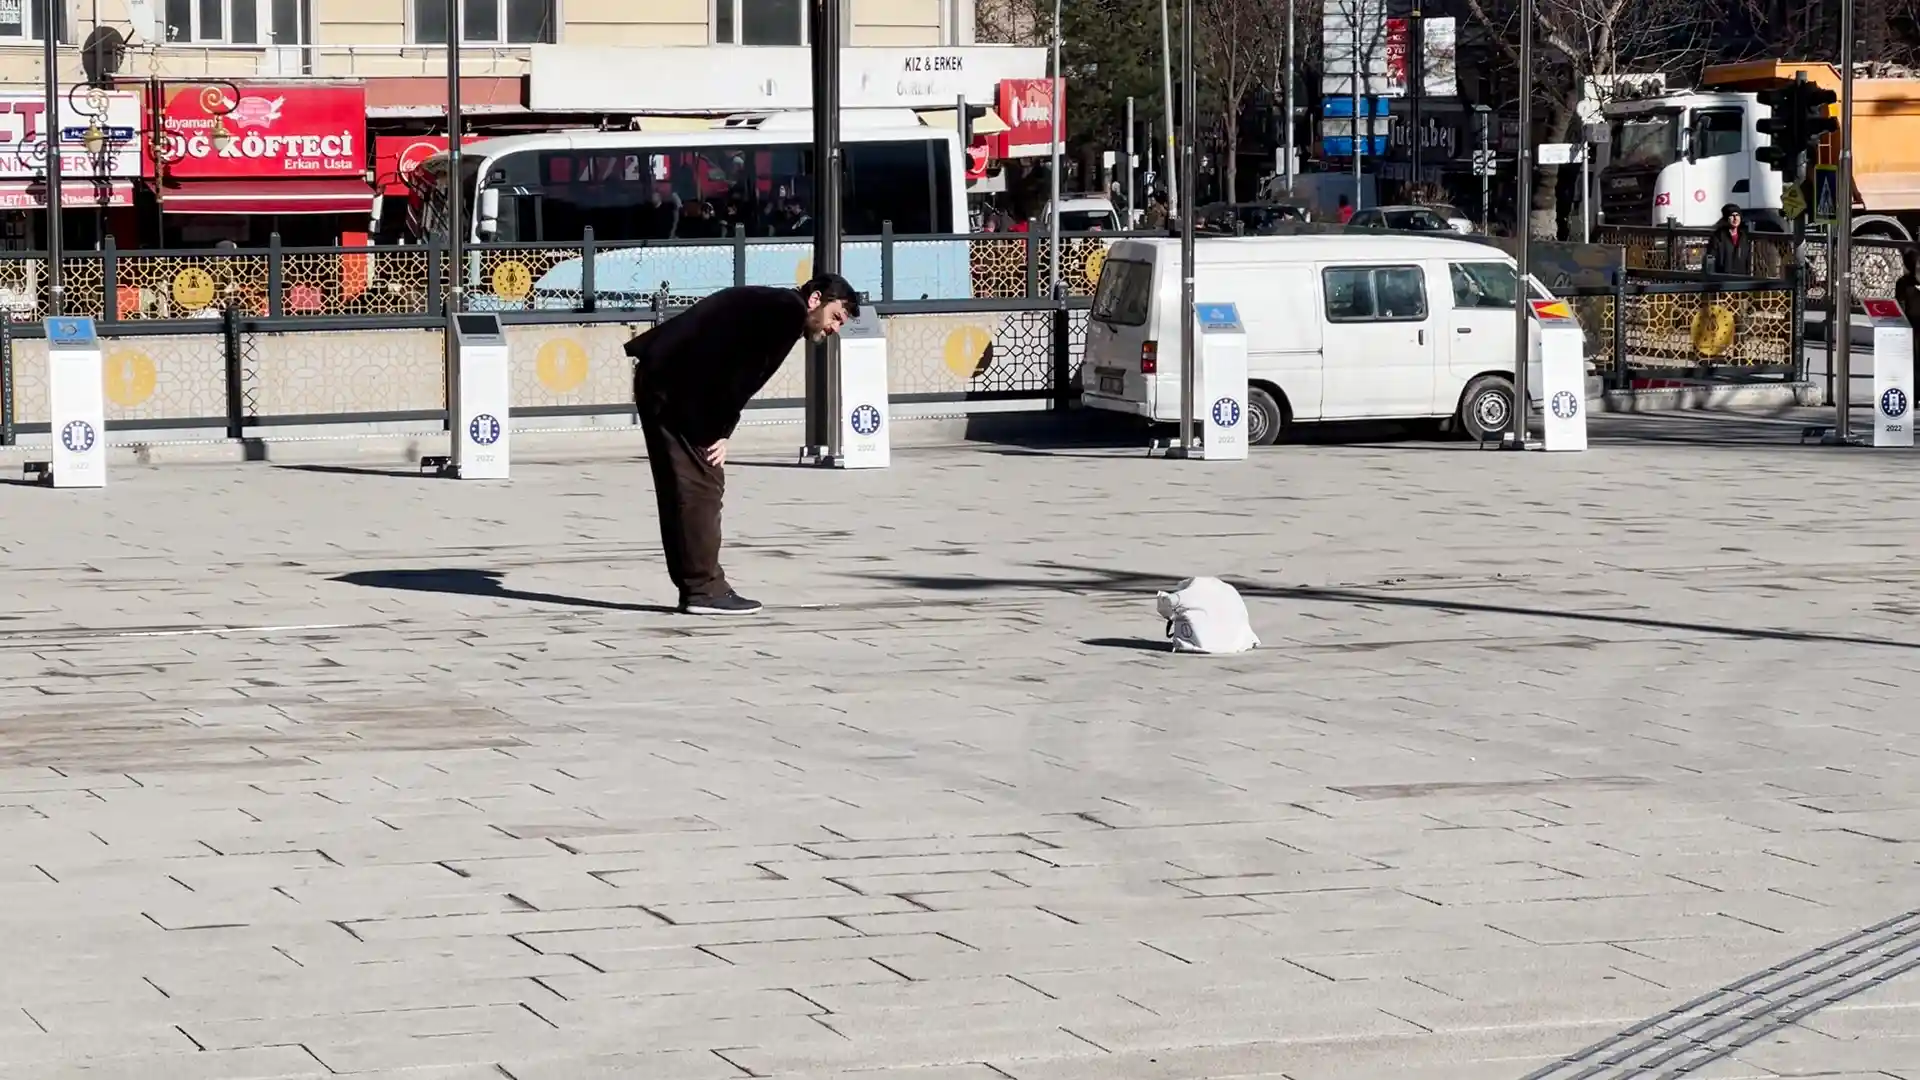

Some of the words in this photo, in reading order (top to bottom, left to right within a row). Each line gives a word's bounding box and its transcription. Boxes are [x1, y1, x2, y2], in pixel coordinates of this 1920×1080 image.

[905, 57, 921, 71] KIZ
[924, 57, 931, 71] &
[934, 57, 963, 71] ERKEK
[284, 159, 320, 169] Erkan
[324, 159, 352, 169] Usta
